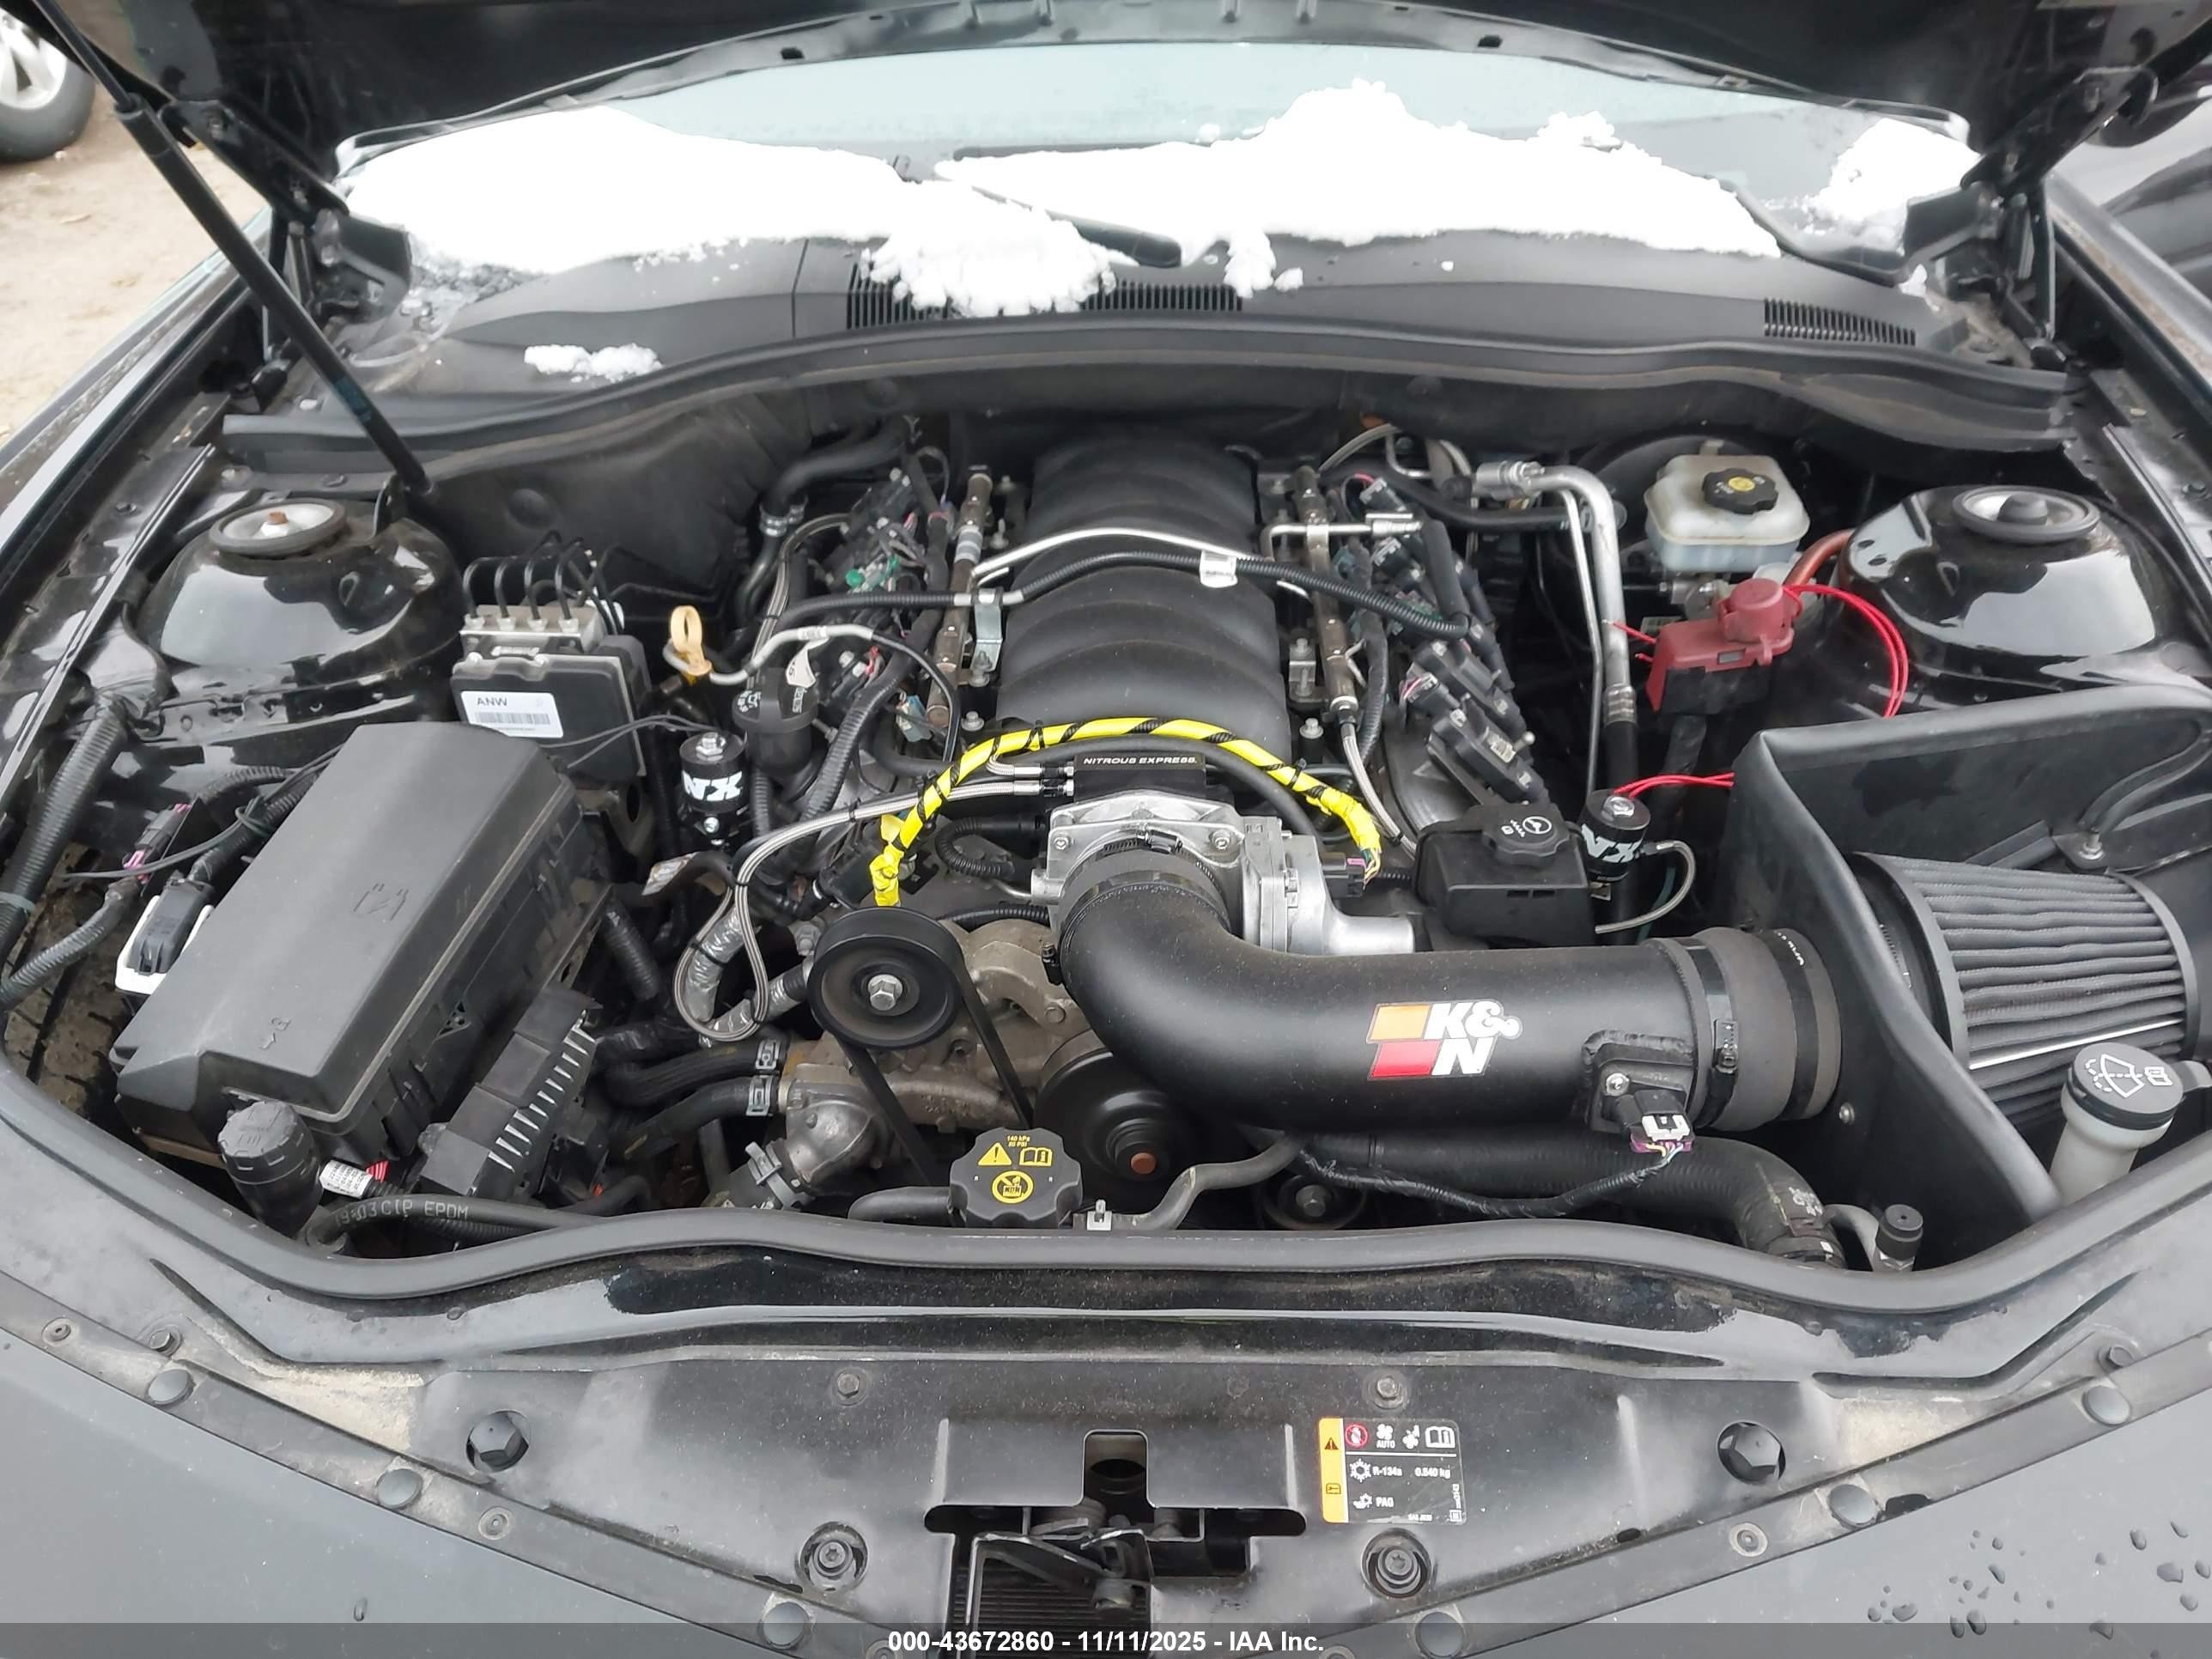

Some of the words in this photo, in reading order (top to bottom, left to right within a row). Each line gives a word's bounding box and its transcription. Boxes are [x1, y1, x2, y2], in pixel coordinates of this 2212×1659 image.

[477, 697, 507, 707] ANW
[1083, 757, 1137, 765] NITROUS
[681, 769, 744, 802] NX
[424, 1200, 469, 1220] EPDM
[1376, 1439, 1395, 1449] AUTO
[1372, 1466, 1403, 1476] R-134a
[1439, 1467, 1452, 1480] kg
